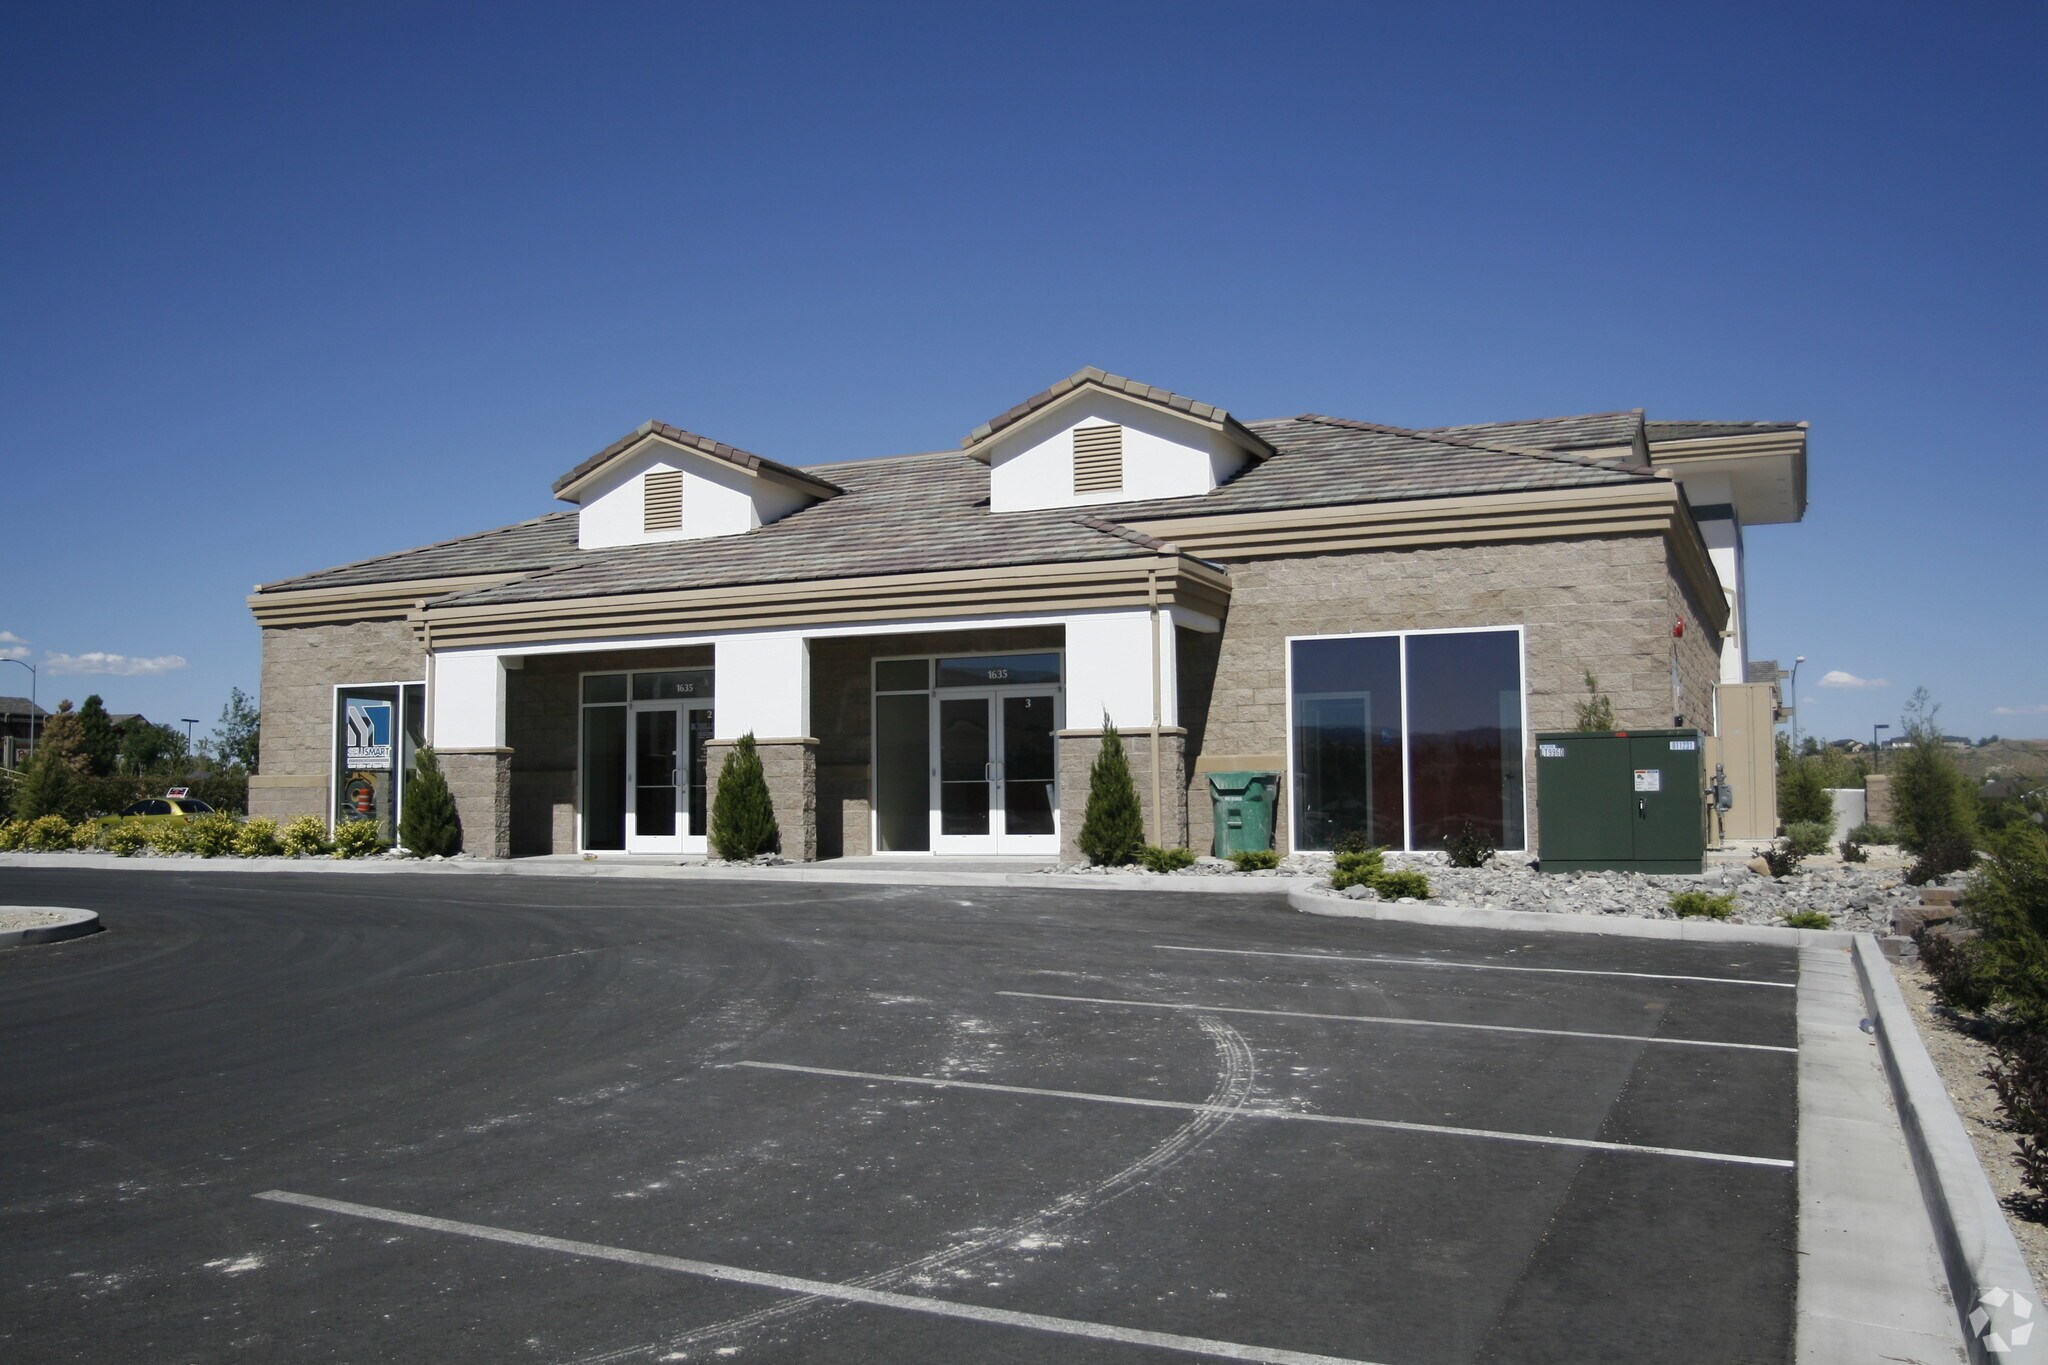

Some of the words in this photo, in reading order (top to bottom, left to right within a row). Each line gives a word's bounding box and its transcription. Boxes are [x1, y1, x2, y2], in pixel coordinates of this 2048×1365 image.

[987, 669, 1008, 679] 1635
[676, 683, 694, 693] 1635
[1025, 698, 1031, 708] 3
[707, 710, 713, 719] 2
